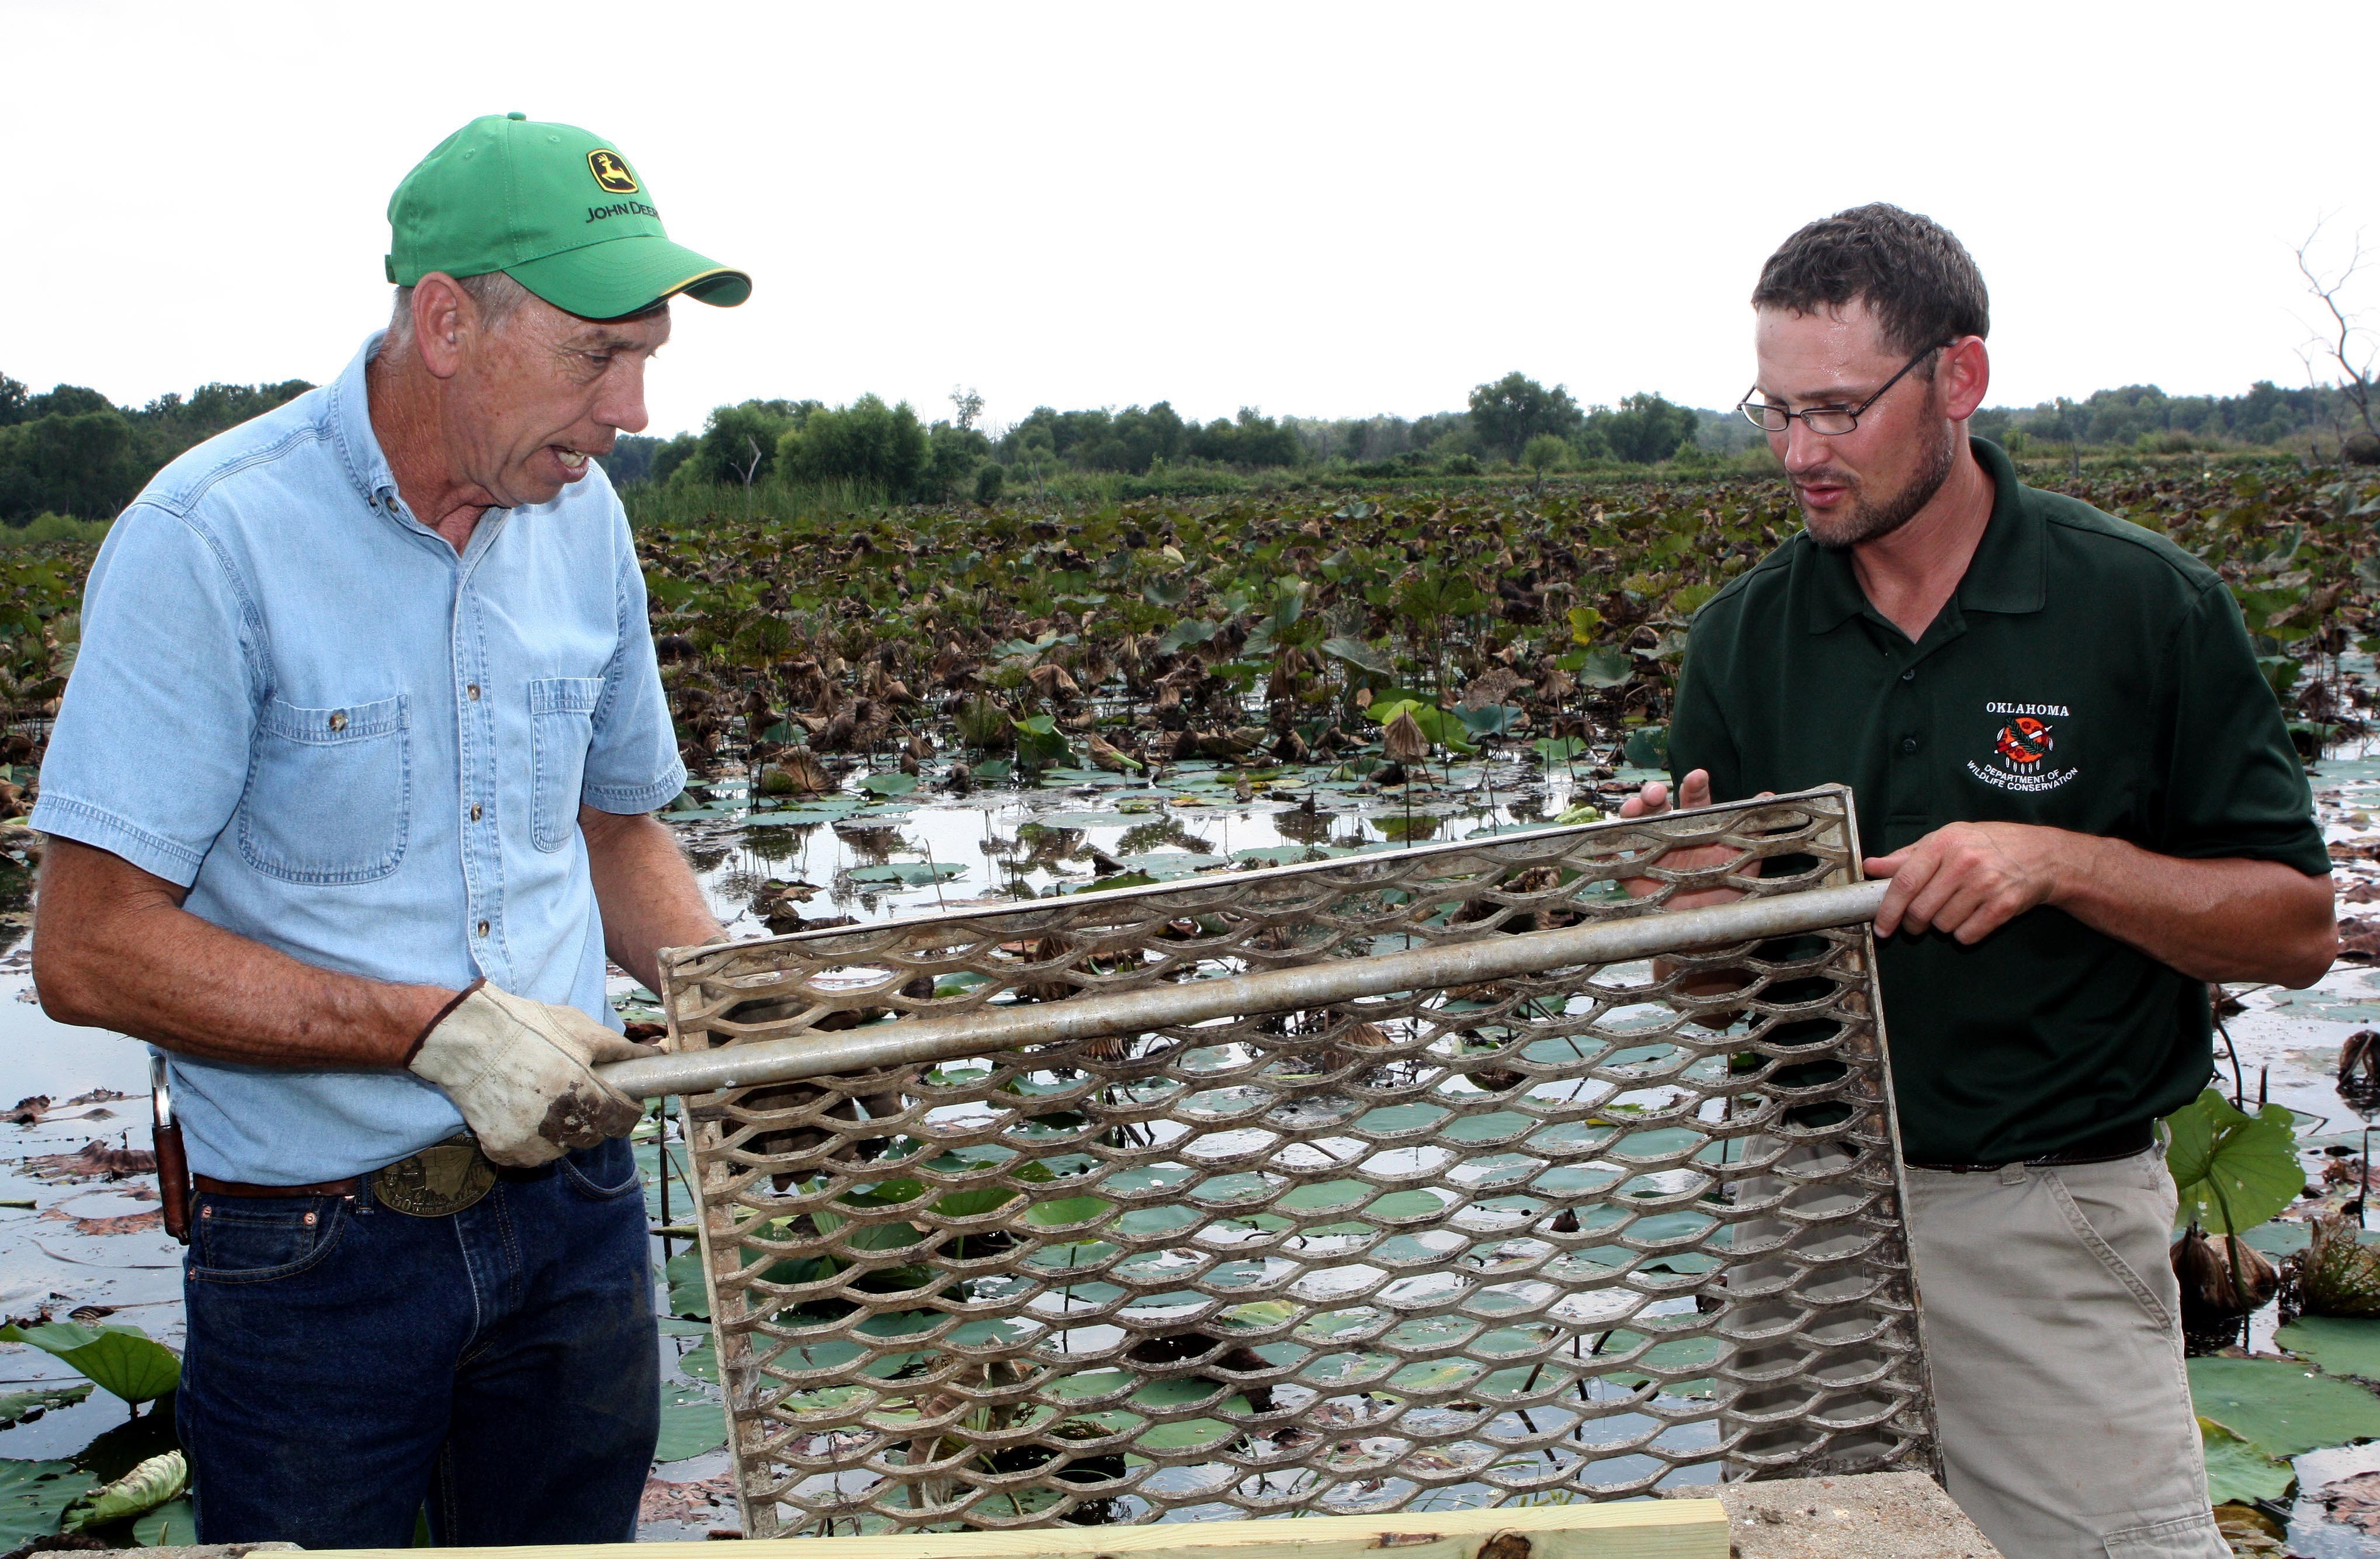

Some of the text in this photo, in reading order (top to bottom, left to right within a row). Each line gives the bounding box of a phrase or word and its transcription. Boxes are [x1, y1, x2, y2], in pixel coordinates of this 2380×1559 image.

[586, 201, 660, 223] JOHN DEER
[1986, 702, 2069, 717] OKLAHOMA
[1966, 760, 2079, 792] WILDLIFE CONSERVATION
[1984, 764, 2059, 784] DEPARTMENT OF
